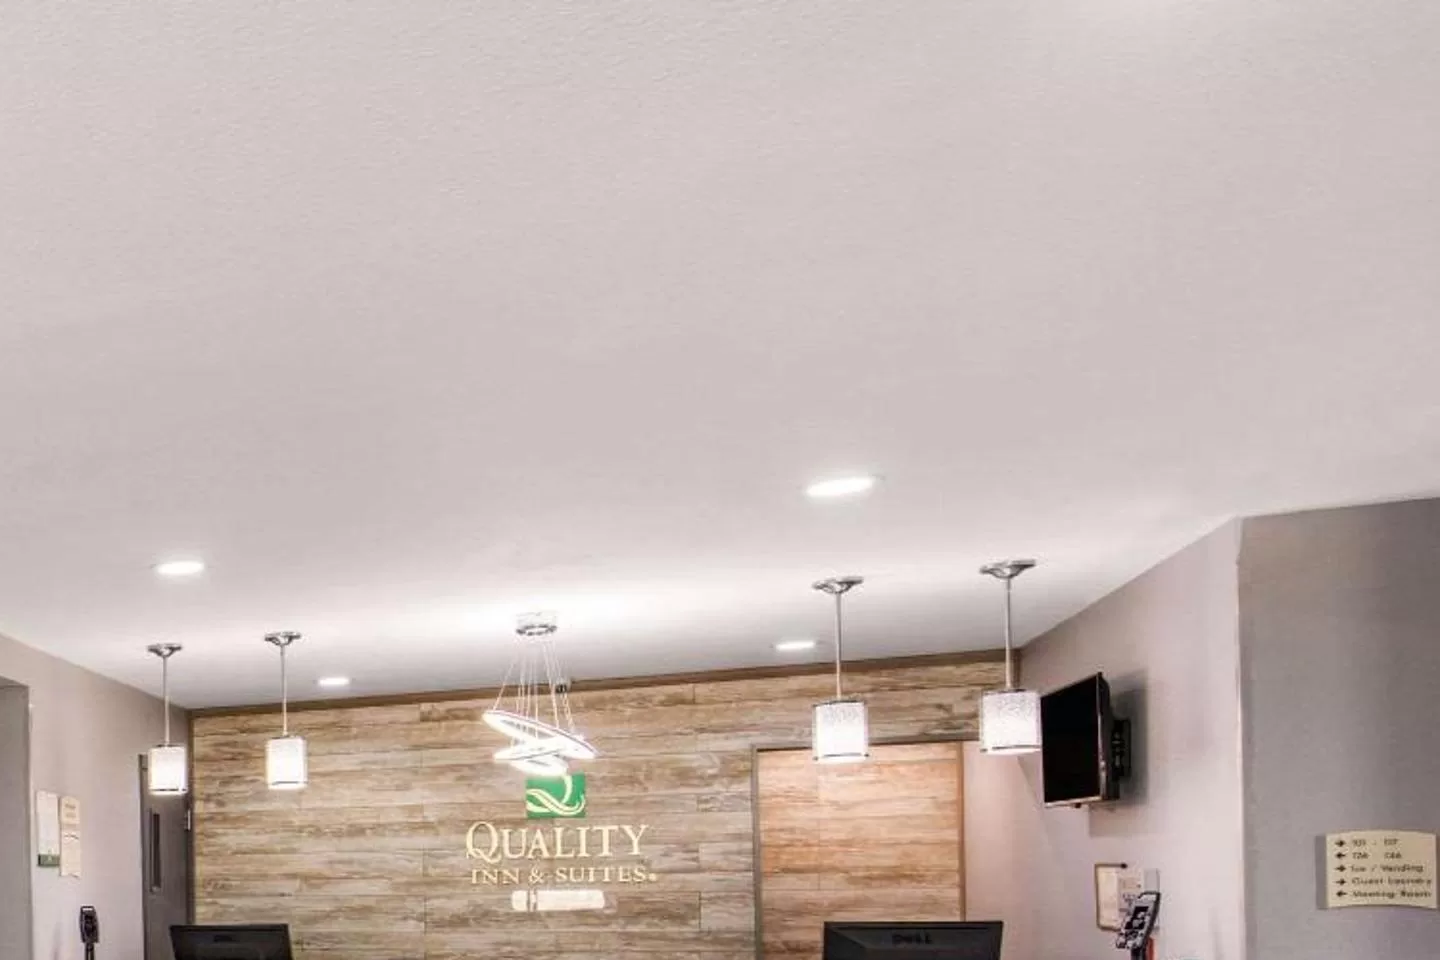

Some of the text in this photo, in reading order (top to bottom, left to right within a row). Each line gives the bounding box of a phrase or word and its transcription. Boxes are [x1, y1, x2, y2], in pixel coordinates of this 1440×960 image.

[466, 821, 649, 864] QUALITY
[471, 865, 648, 885] INN & SUITES
